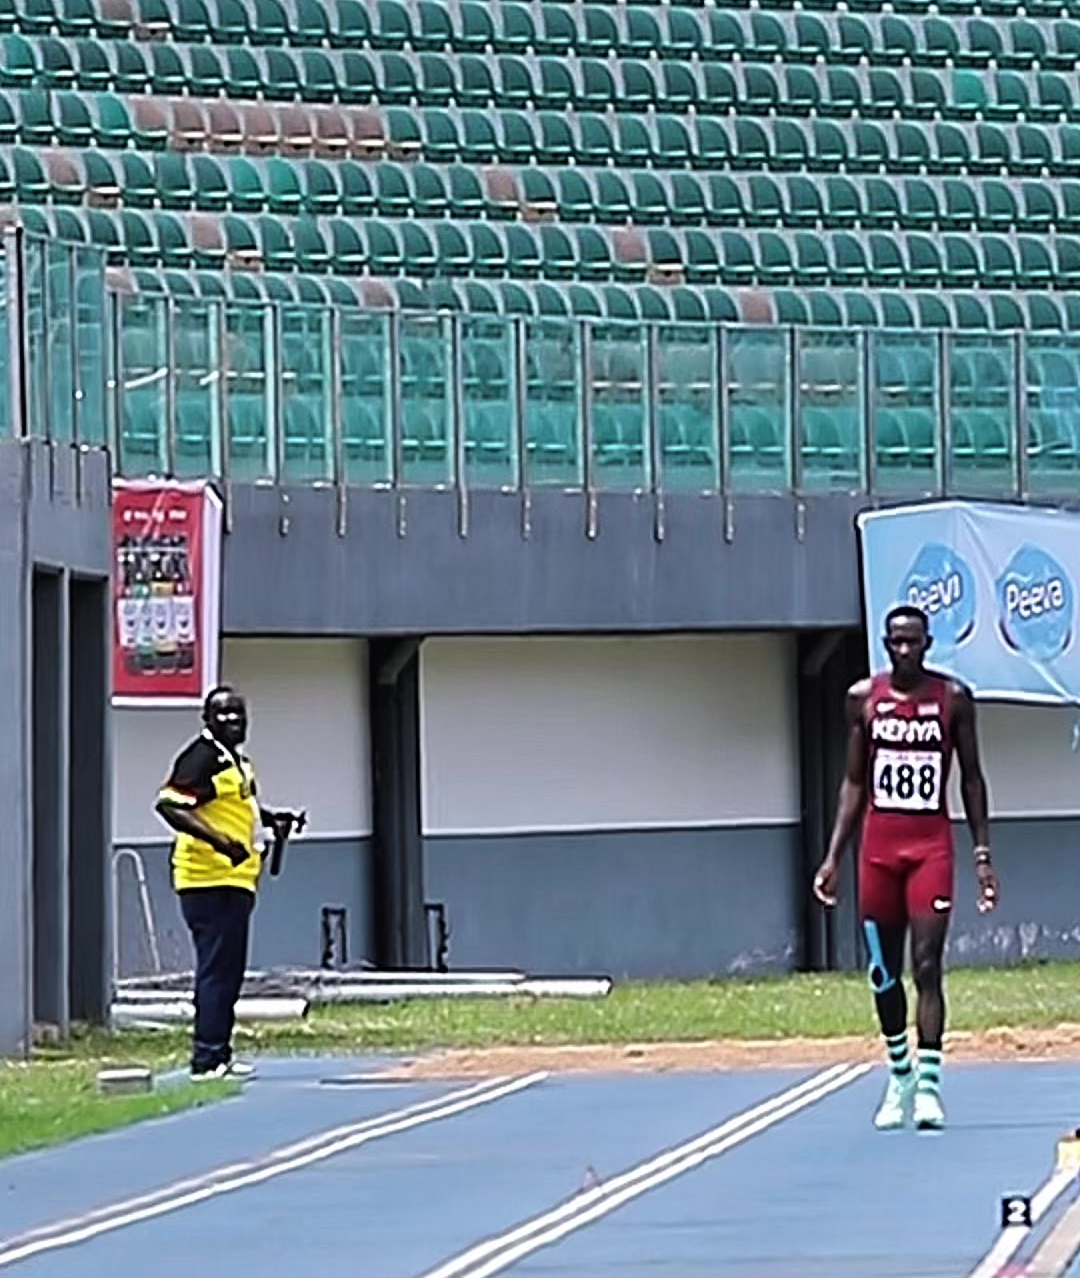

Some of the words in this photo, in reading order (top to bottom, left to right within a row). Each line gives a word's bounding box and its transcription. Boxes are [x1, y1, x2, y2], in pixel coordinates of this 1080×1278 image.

[1006, 578, 1064, 618] Peeva
[872, 718, 942, 742] KENYA
[879, 763, 936, 801] 488
[1007, 1200, 1027, 1222] 2
